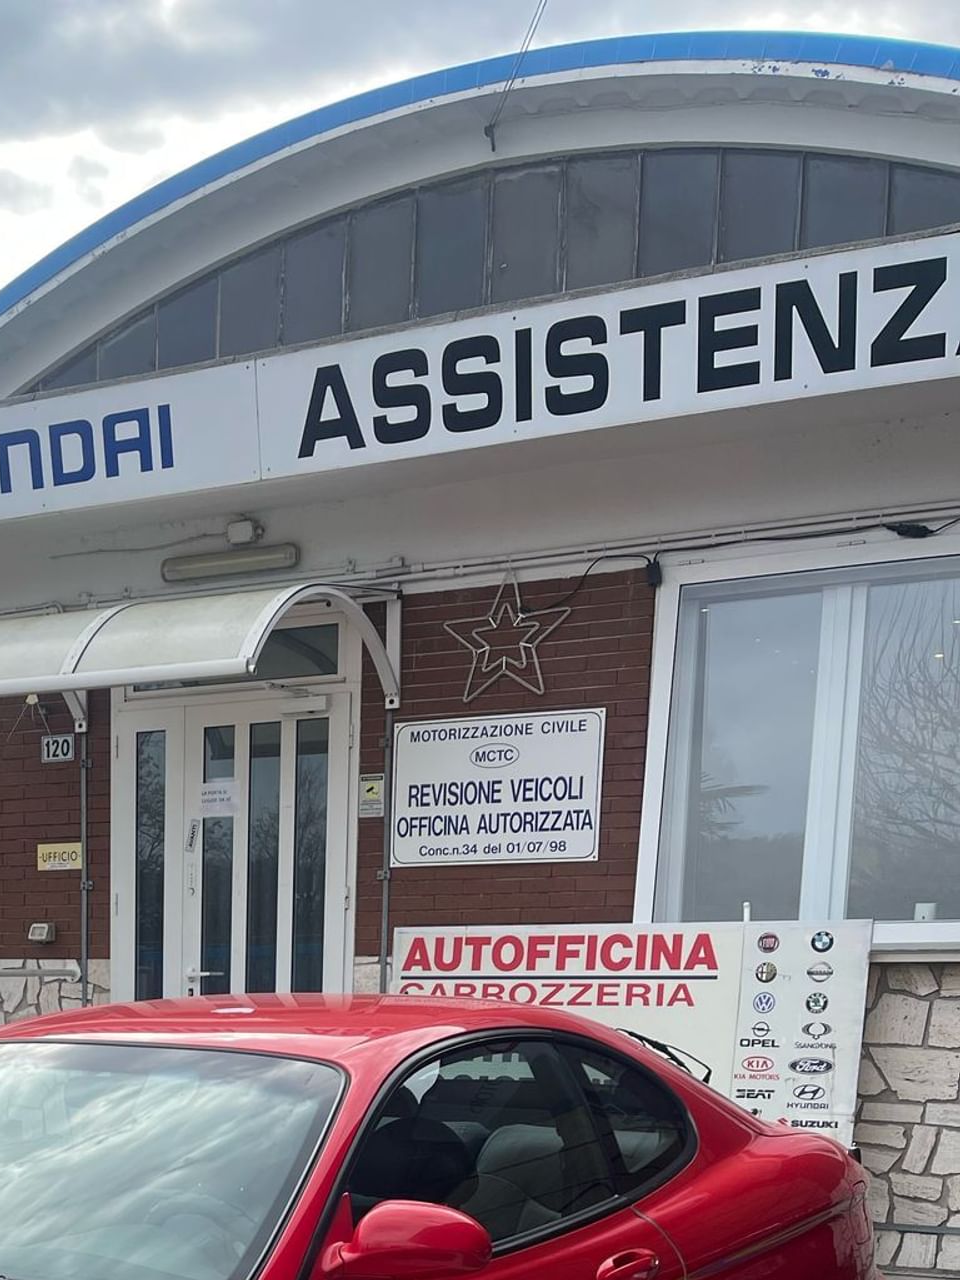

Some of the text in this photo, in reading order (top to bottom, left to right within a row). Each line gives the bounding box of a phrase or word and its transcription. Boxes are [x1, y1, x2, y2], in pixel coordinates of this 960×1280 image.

[298, 257, 960, 458] ASSISTENZ
[410, 719, 587, 743] MOTORIZZAZIONE CIVILE
[45, 739, 70, 758] 120
[474, 749, 514, 762] MCTC
[408, 780, 502, 808] REVISIONE
[511, 775, 584, 802] VEICOLI
[397, 809, 593, 838] OFFICINA AUTORIZZATA
[483, 843, 501, 854] del
[507, 841, 567, 854] 01/07/98
[42, 851, 77, 863] UFFICIO
[401, 933, 719, 972] AUTOFFICINA
[740, 1039, 780, 1047] OPEL
[795, 1061, 828, 1072] Ford
[736, 1089, 775, 1099] SEAT
[786, 1102, 829, 1110] HYUNDAI
[791, 1120, 839, 1129] SUZUKI
